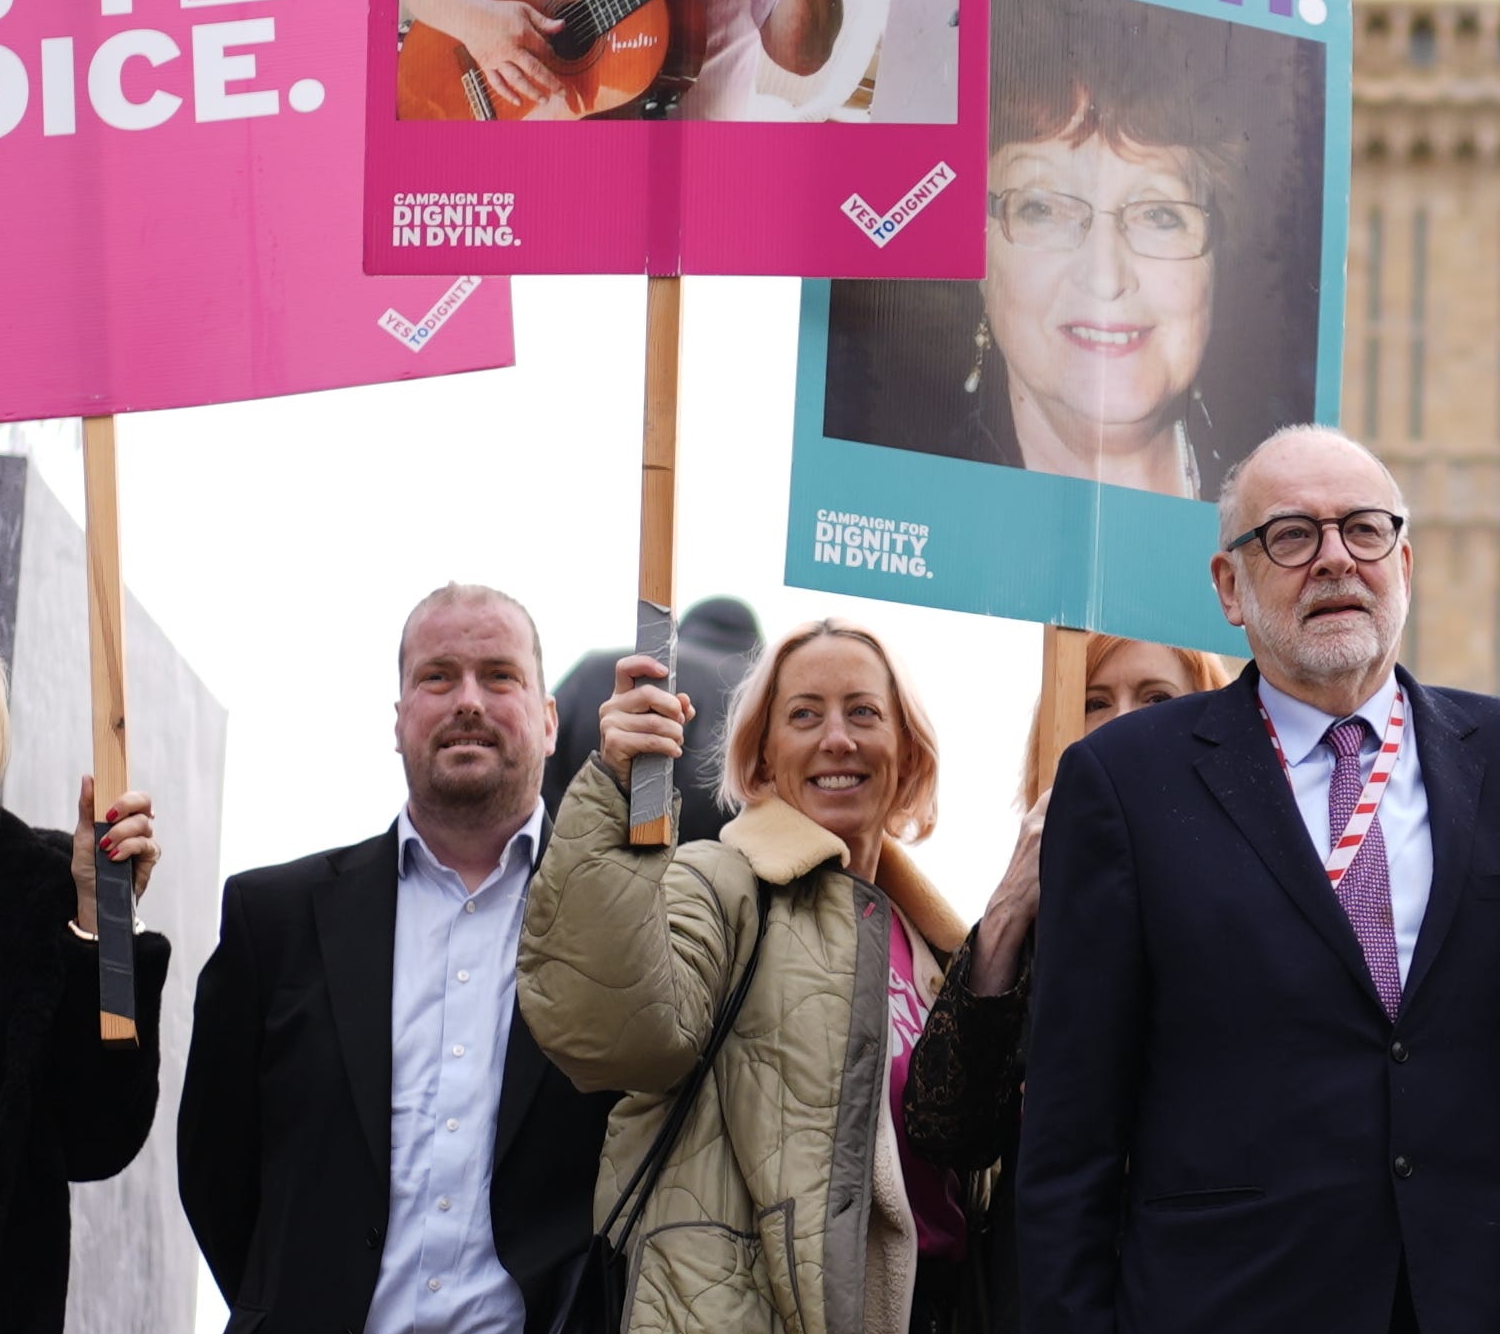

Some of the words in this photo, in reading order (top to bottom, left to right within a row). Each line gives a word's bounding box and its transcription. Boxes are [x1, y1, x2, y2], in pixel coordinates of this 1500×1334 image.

[394, 193, 477, 205] CAMPAIGN
[484, 193, 514, 204] FOR
[394, 206, 513, 225] DIGNITY
[849, 199, 878, 230] YES
[393, 227, 420, 245] IN
[818, 510, 894, 531] CAMPAIGN
[900, 523, 928, 536] FOR
[816, 522, 927, 556] DIGNITY
[816, 543, 840, 563] IN
